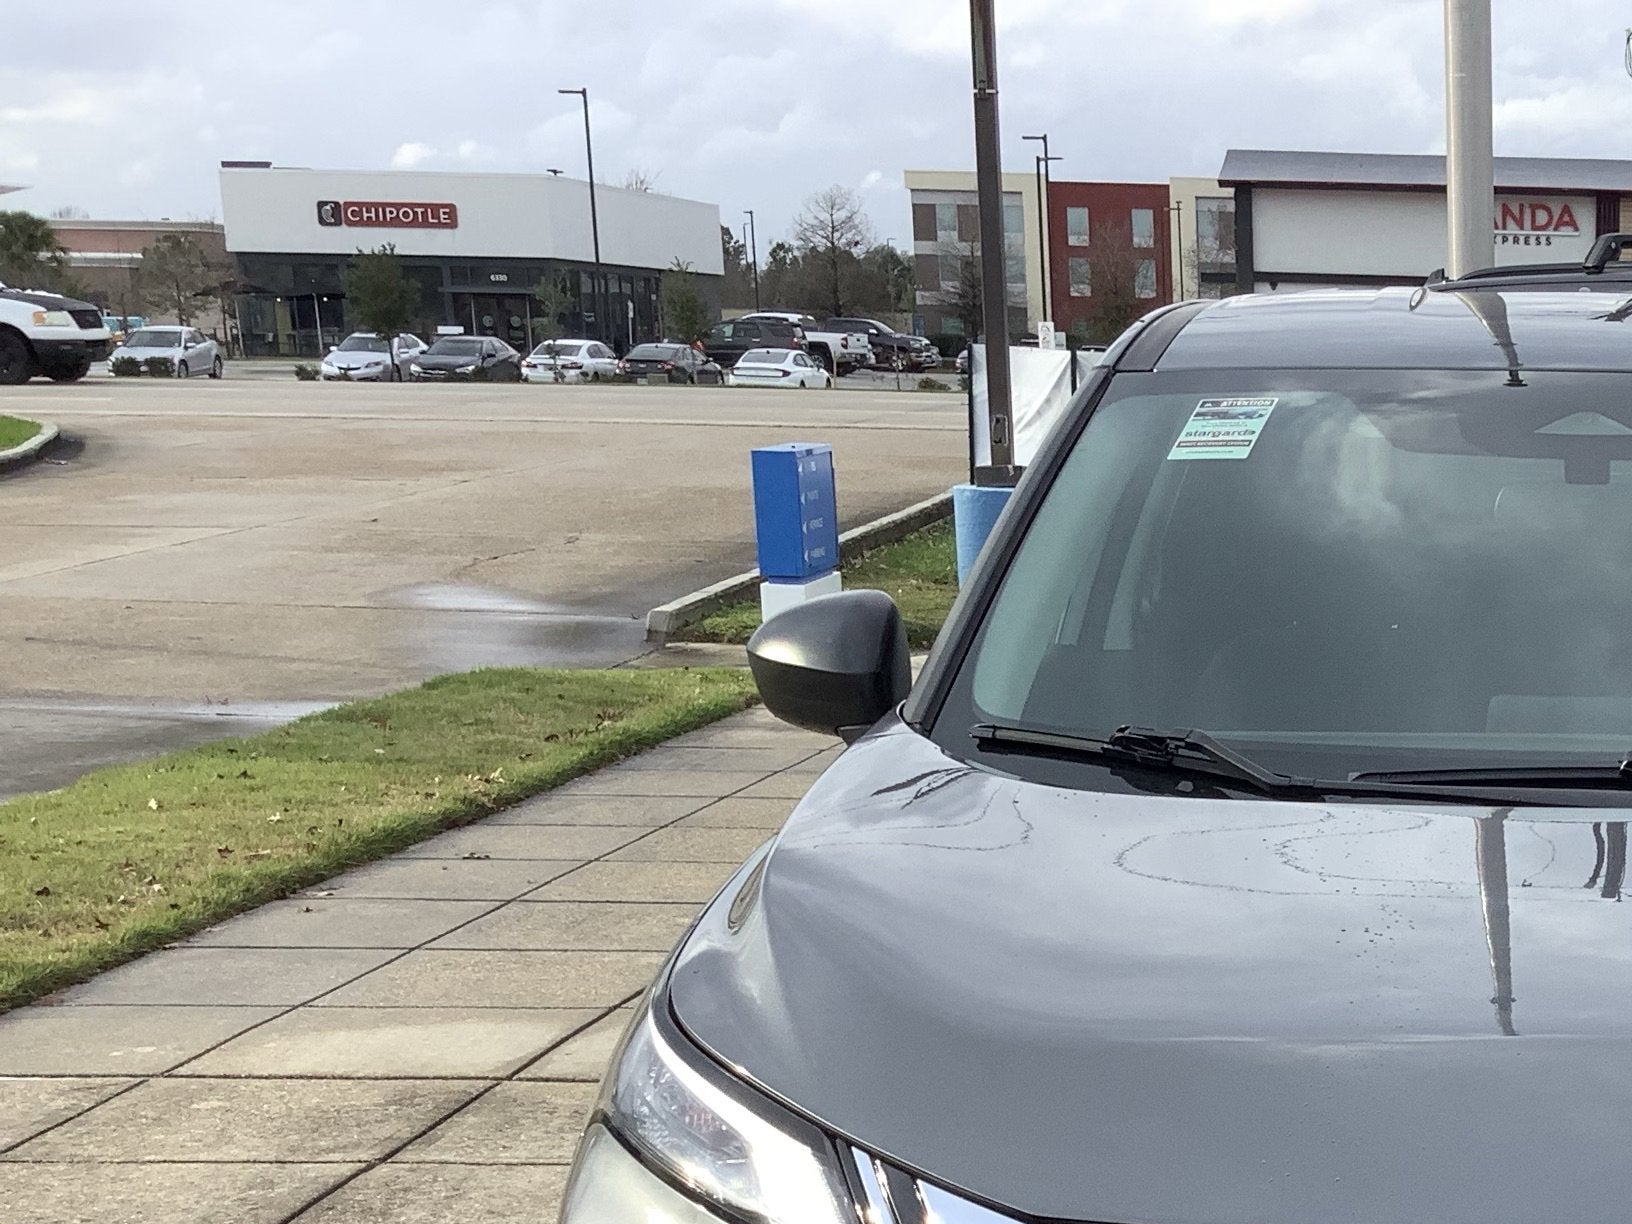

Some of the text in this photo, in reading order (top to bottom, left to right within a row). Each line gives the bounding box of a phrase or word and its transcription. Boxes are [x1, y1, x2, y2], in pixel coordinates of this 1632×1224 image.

[347, 206, 452, 223] CHIPOTLE
[1494, 203, 1580, 232] NDA
[1220, 400, 1271, 408] ATTENTION
